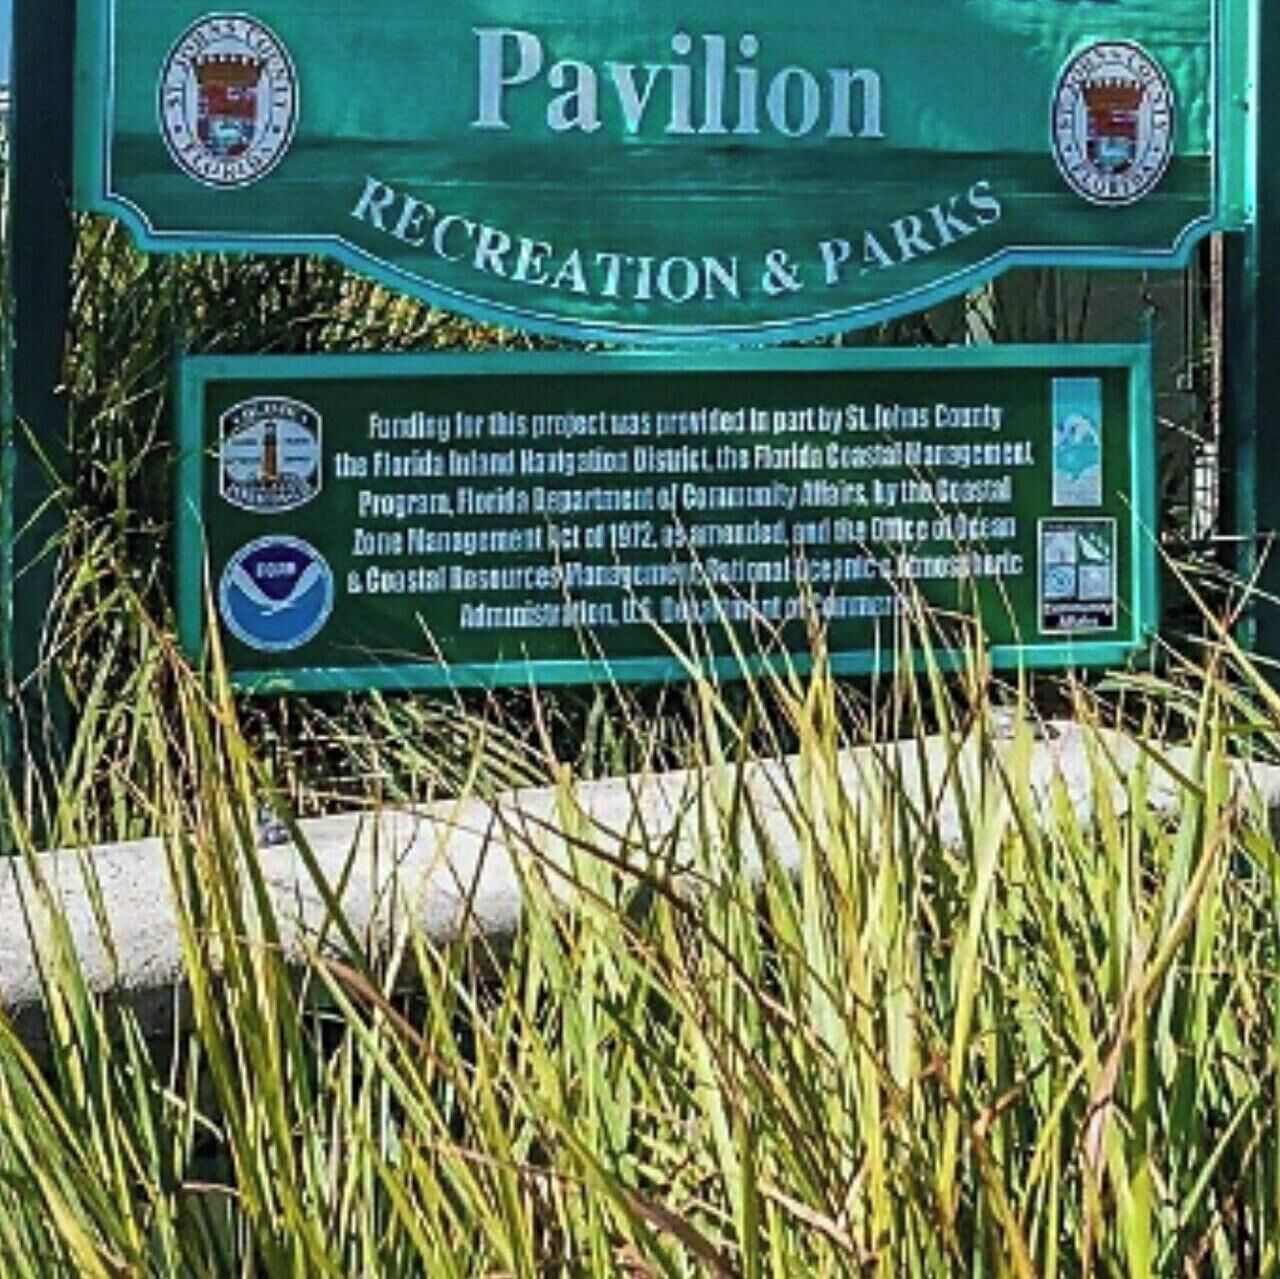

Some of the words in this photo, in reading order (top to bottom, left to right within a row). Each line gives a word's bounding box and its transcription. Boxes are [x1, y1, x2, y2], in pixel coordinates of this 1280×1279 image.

[472, 26, 886, 138] Pavilion
[351, 175, 740, 301] RECREATION
[761, 249, 803, 296] &
[818, 180, 1002, 285] PARKS
[369, 411, 450, 442] Funding
[455, 411, 484, 438] for
[489, 410, 527, 437] this
[532, 410, 606, 440] project
[611, 411, 650, 435] was
[656, 407, 744, 438] provided
[773, 406, 816, 435] part
[818, 406, 844, 434] by
[874, 404, 929, 431] Johns
[934, 403, 1003, 431] County
[335, 451, 368, 478] the
[373, 450, 445, 477] Florida
[449, 449, 515, 477] Inland
[520, 446, 628, 477] Navigation
[717, 444, 750, 470] the
[754, 442, 822, 469] Florida
[825, 441, 902, 468] Coastal
[359, 489, 455, 518] Program,
[456, 487, 529, 515] Florida
[532, 485, 654, 513] Department
[656, 483, 679, 511] of
[683, 481, 797, 511] Community
[873, 478, 897, 506] by
[935, 476, 1013, 504] Coastal
[352, 527, 403, 556] Zone
[407, 525, 543, 556] Management
[584, 523, 606, 549] of
[792, 518, 830, 544] and
[872, 517, 929, 542] Office
[955, 514, 1016, 539] Ocean
[366, 566, 447, 594] Coastal
[450, 563, 564, 591] Resources
